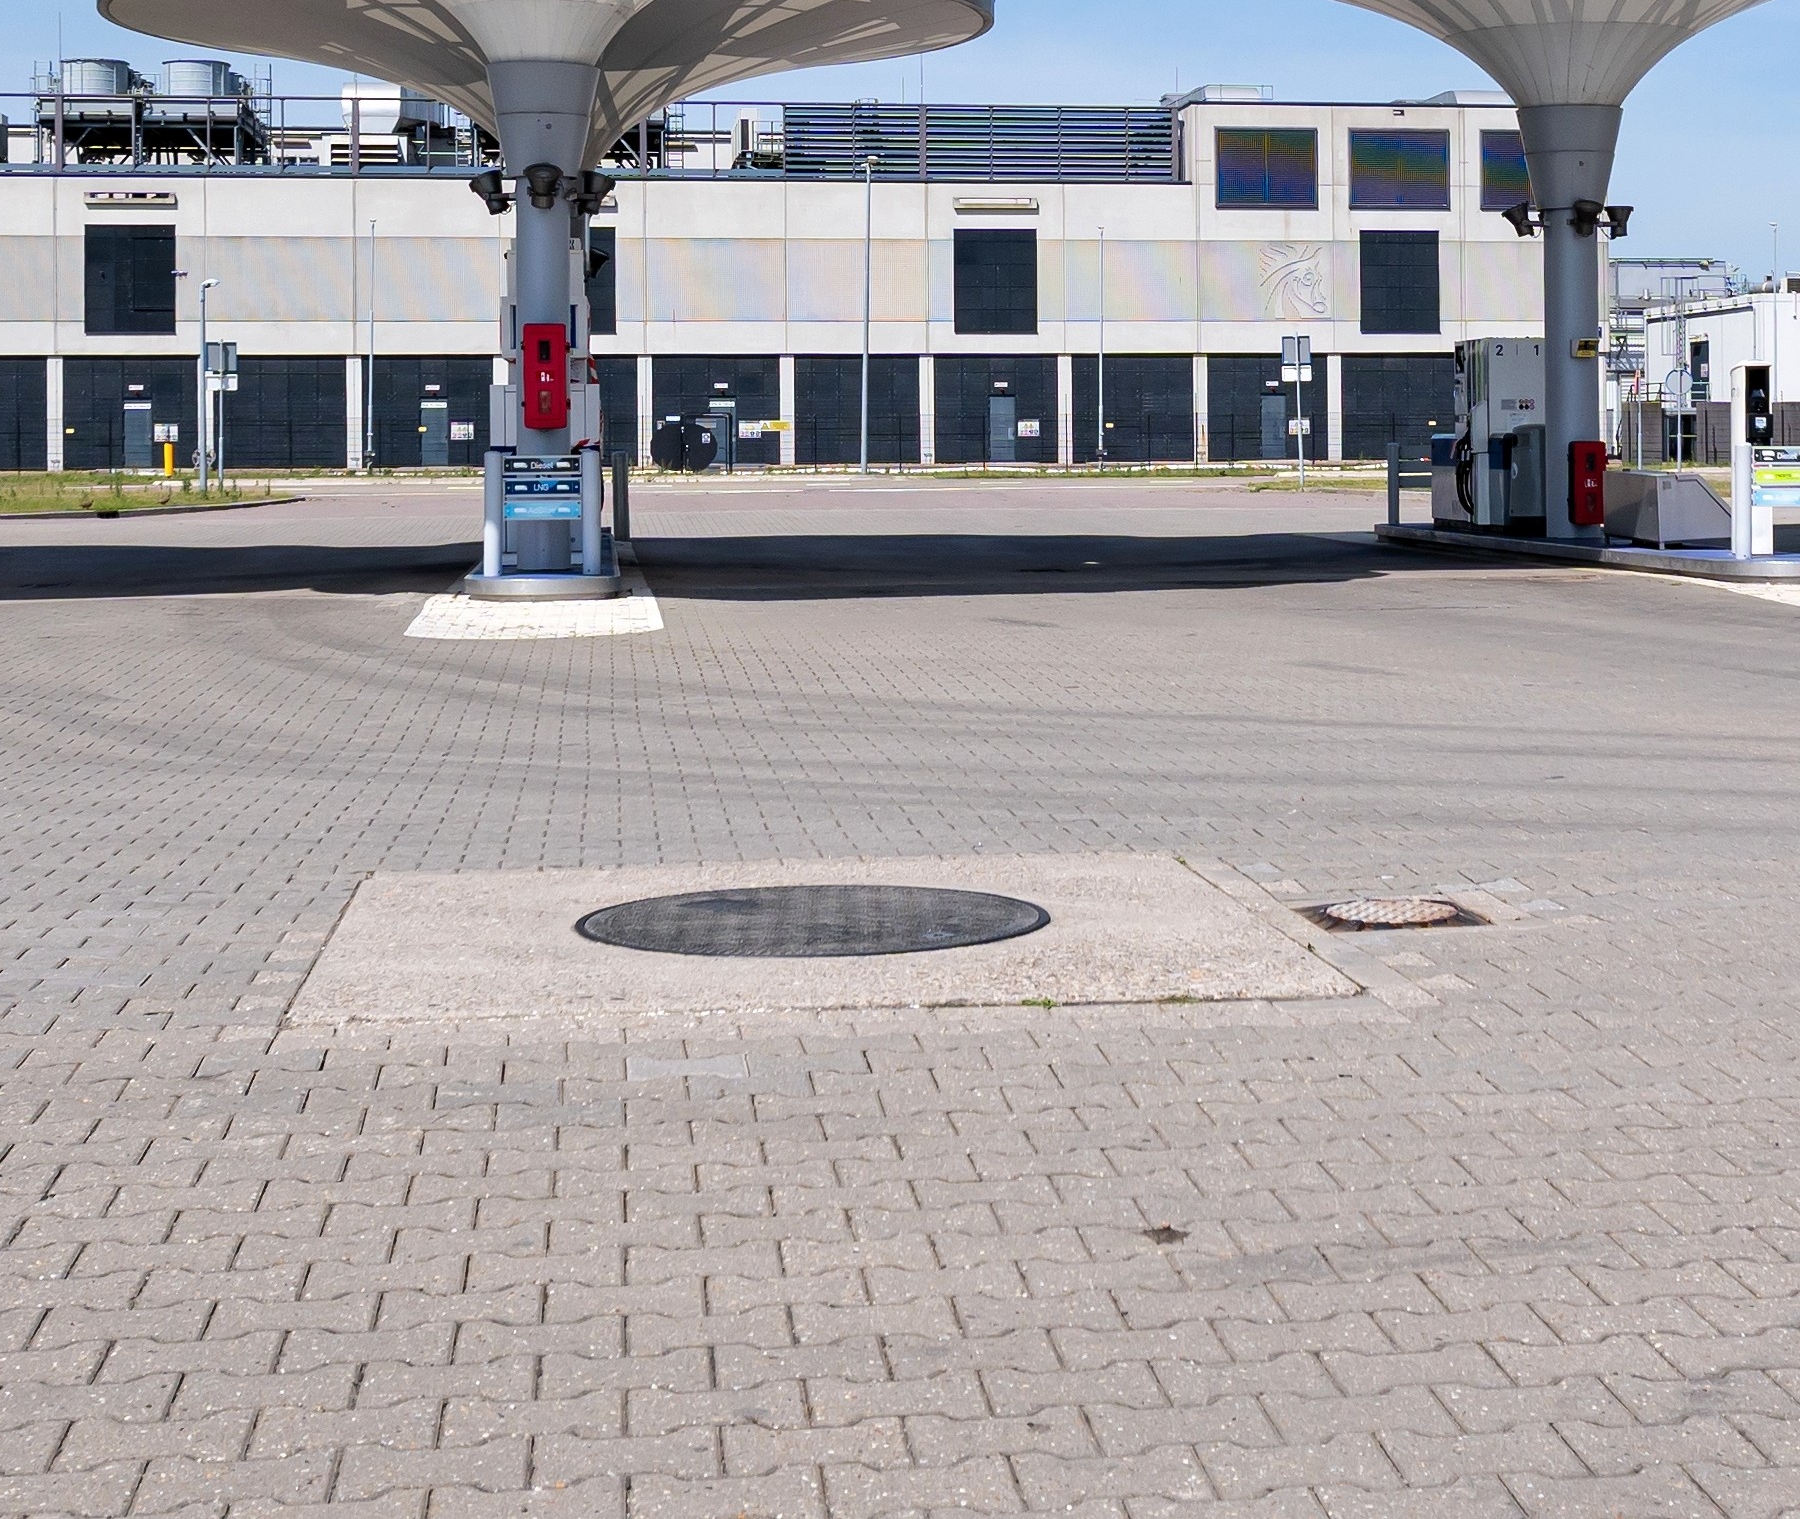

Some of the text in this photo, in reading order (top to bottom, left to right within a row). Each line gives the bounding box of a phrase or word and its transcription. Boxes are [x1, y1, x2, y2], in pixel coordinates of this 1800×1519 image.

[1495, 345, 1540, 356] 2 1
[530, 461, 554, 469] Diesel
